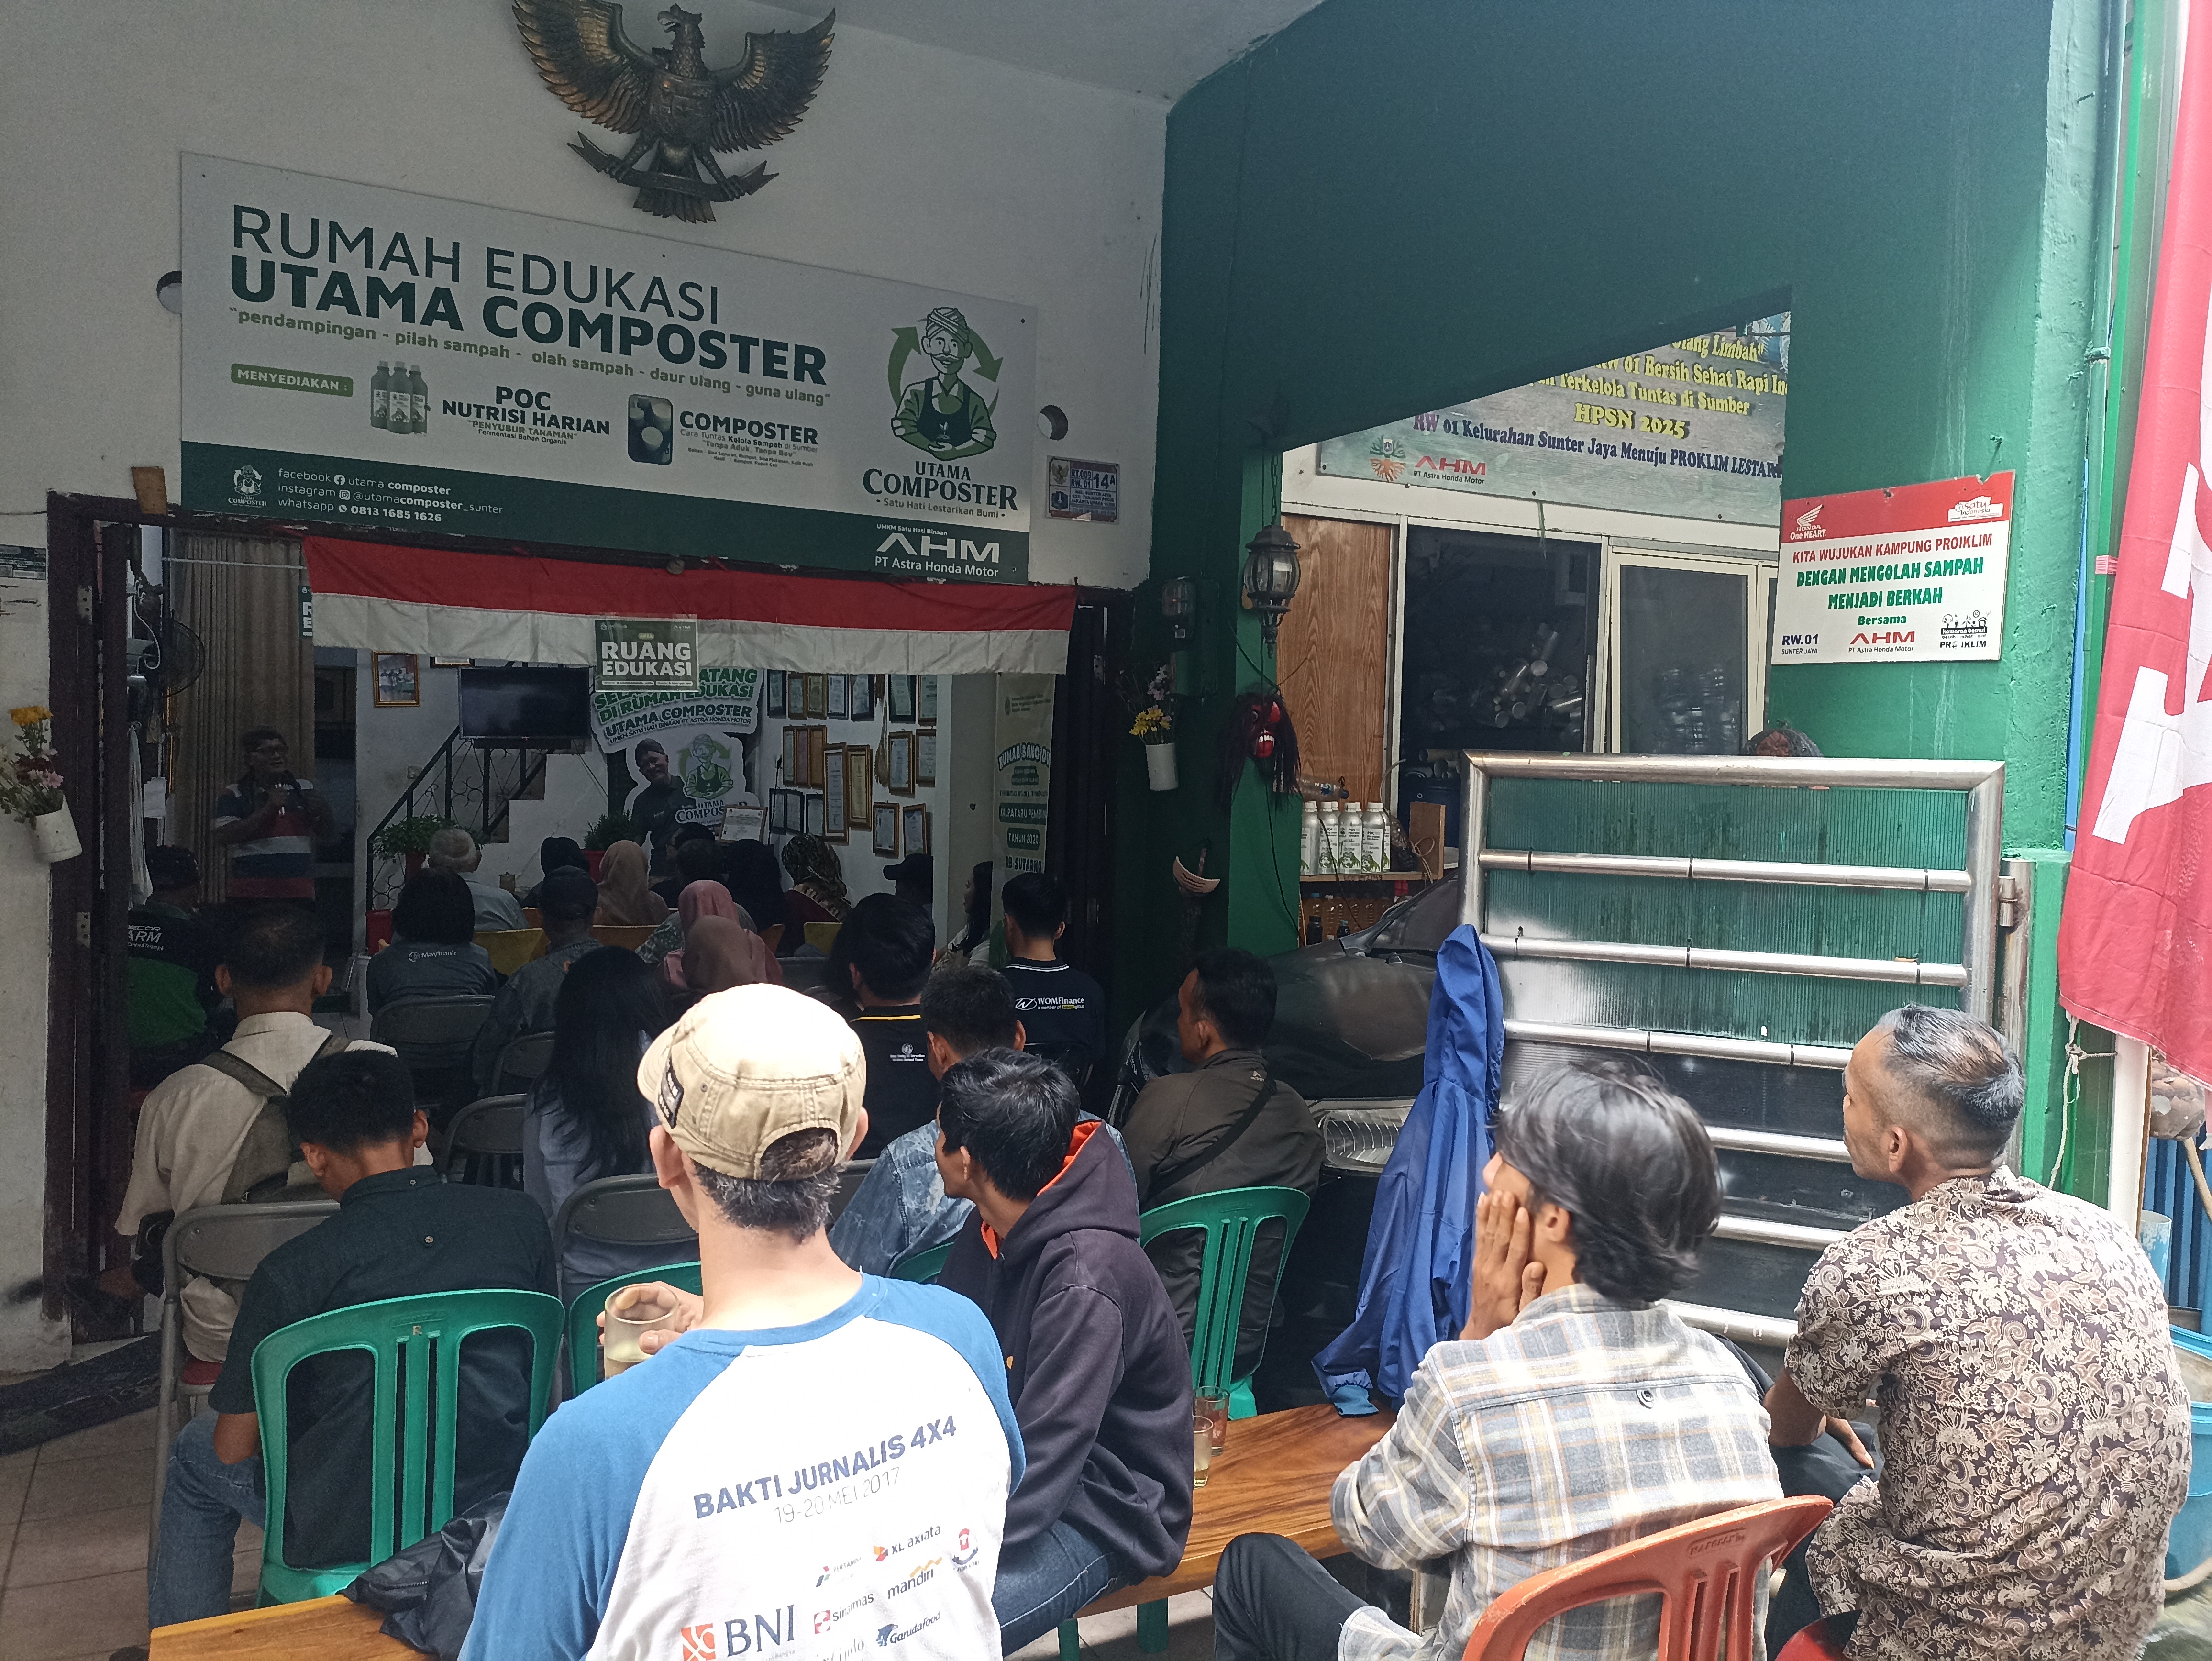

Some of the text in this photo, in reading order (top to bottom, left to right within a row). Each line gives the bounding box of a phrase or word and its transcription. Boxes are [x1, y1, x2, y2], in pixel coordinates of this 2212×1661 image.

[233, 204, 718, 324] RUMAH EDUKASI
[231, 255, 827, 385] UTAMA COMPOSTER
[395, 331, 438, 349] pilah
[443, 338, 510, 360] sampah
[531, 349, 567, 367] olah
[571, 355, 634, 378] sampah
[650, 366, 686, 384] daur
[689, 375, 731, 394] ulang
[746, 384, 781, 399] guna
[1645, 355, 1690, 381] Bersih
[1693, 364, 1734, 388] Sehat
[1736, 369, 1770, 396] Rapi
[237, 368, 340, 391] MENYEDIAKAN
[496, 386, 551, 411] POC
[1560, 373, 1625, 398] Terkelola
[1627, 381, 1677, 405] Tuntas
[1680, 390, 1694, 407] di
[1698, 392, 1750, 415] Sumber
[442, 400, 610, 435] NUTRISI HARIAN
[680, 410, 818, 445] COMPOSTER
[1575, 403, 1686, 439] HPSN 2025
[478, 429, 567, 445] Fermentasi Bahan Organik
[680, 428, 698, 438] Cara
[701, 431, 726, 442] Tuntas
[728, 435, 752, 445] Kelola
[753, 439, 783, 449] Sampah
[793, 443, 818, 454] Sumber
[1413, 414, 1438, 431] RW
[1462, 419, 1535, 446] Kelurahan
[1539, 430, 1585, 453] Sunter
[1589, 437, 1618, 461] Jaya
[1621, 441, 1667, 466] Menuju
[1670, 449, 1729, 472] PROKLIM
[755, 446, 777, 456] Tanpa
[915, 460, 971, 481] UTAMA
[1415, 455, 1486, 476] AHM
[1424, 471, 1440, 480] Astra
[1442, 474, 1463, 482] Honda
[1465, 476, 1484, 485] Motor
[278, 467, 451, 496] facebook utama composter
[863, 468, 1018, 511] COMPOSTER
[228, 497, 267, 507] COMPOSTER
[278, 483, 503, 516] instagram @utamacomposter_sunter
[278, 498, 442, 523] whatsapp 0813 1685 1626
[883, 497, 998, 519] Satu Hati Lestarikan Bumi
[876, 532, 1000, 564] AHM
[1790, 532, 1803, 540] One
[1792, 533, 1992, 563] KITA WUJUKAN KAMPUNG PROIKLIM
[874, 556, 999, 577] PT Astra Honda Motor
[1796, 557, 1984, 587] DENGAN MENGOLAH SAMPAH
[1828, 587, 1943, 609] MENJADI BERKAH
[1858, 614, 1907, 626] Bersama
[1781, 634, 1819, 646] RW.01
[1850, 631, 1915, 644] AHM
[602, 642, 691, 660] RUANG
[602, 661, 692, 676] EDUKASI
[599, 708, 618, 724] DI
[622, 692, 681, 714] RUMAH
[605, 704, 752, 737] UTAMA COMPOSTER
[610, 734, 628, 743] UMKM
[629, 728, 644, 737] SATU
[659, 720, 680, 728] BINAAN
[698, 799, 724, 809] UTAMA
[1008, 833, 1039, 845] TAHUN 2020
[413, 1325, 422, 1335] R
[694, 1415, 956, 1519] BAKTI JURNALIS 4X4
[774, 1467, 900, 1523] 19-20 MEI 2017
[891, 1525, 941, 1555] XL axiata
[887, 1569, 934, 1600] mandiri
[724, 1604, 795, 1657] BNI
